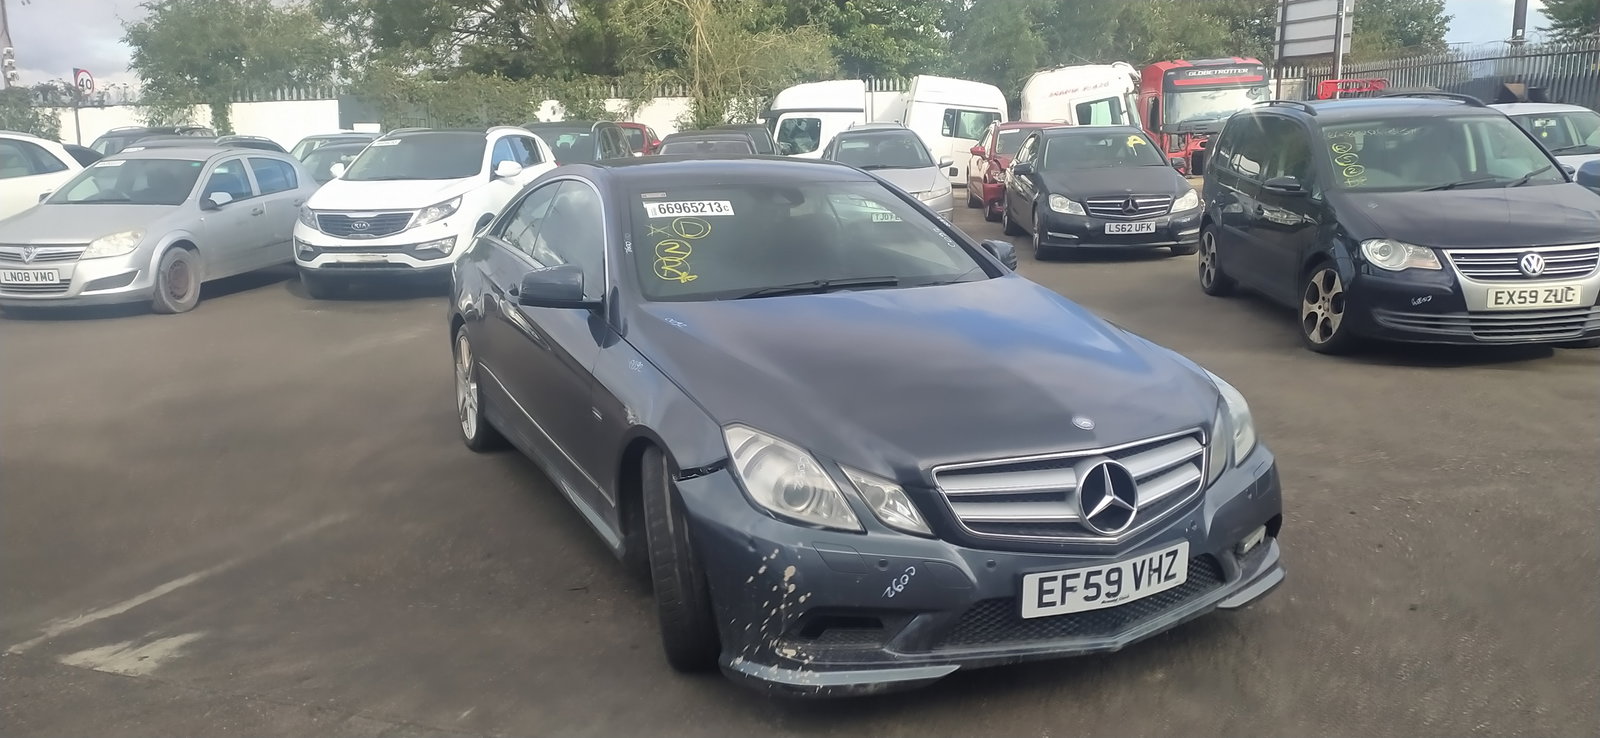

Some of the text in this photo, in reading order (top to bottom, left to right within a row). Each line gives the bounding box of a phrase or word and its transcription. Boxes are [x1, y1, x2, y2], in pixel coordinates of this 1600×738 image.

[1187, 68, 1249, 77] GLOBETROTTER
[78, 77, 92, 92] 40
[1108, 222, 1153, 233] LS62 UFK
[3, 271, 31, 282] LN08
[1494, 289, 1539, 305] EX59
[881, 566, 916, 599] C092
[1037, 549, 1179, 609] EF59 VHZ
